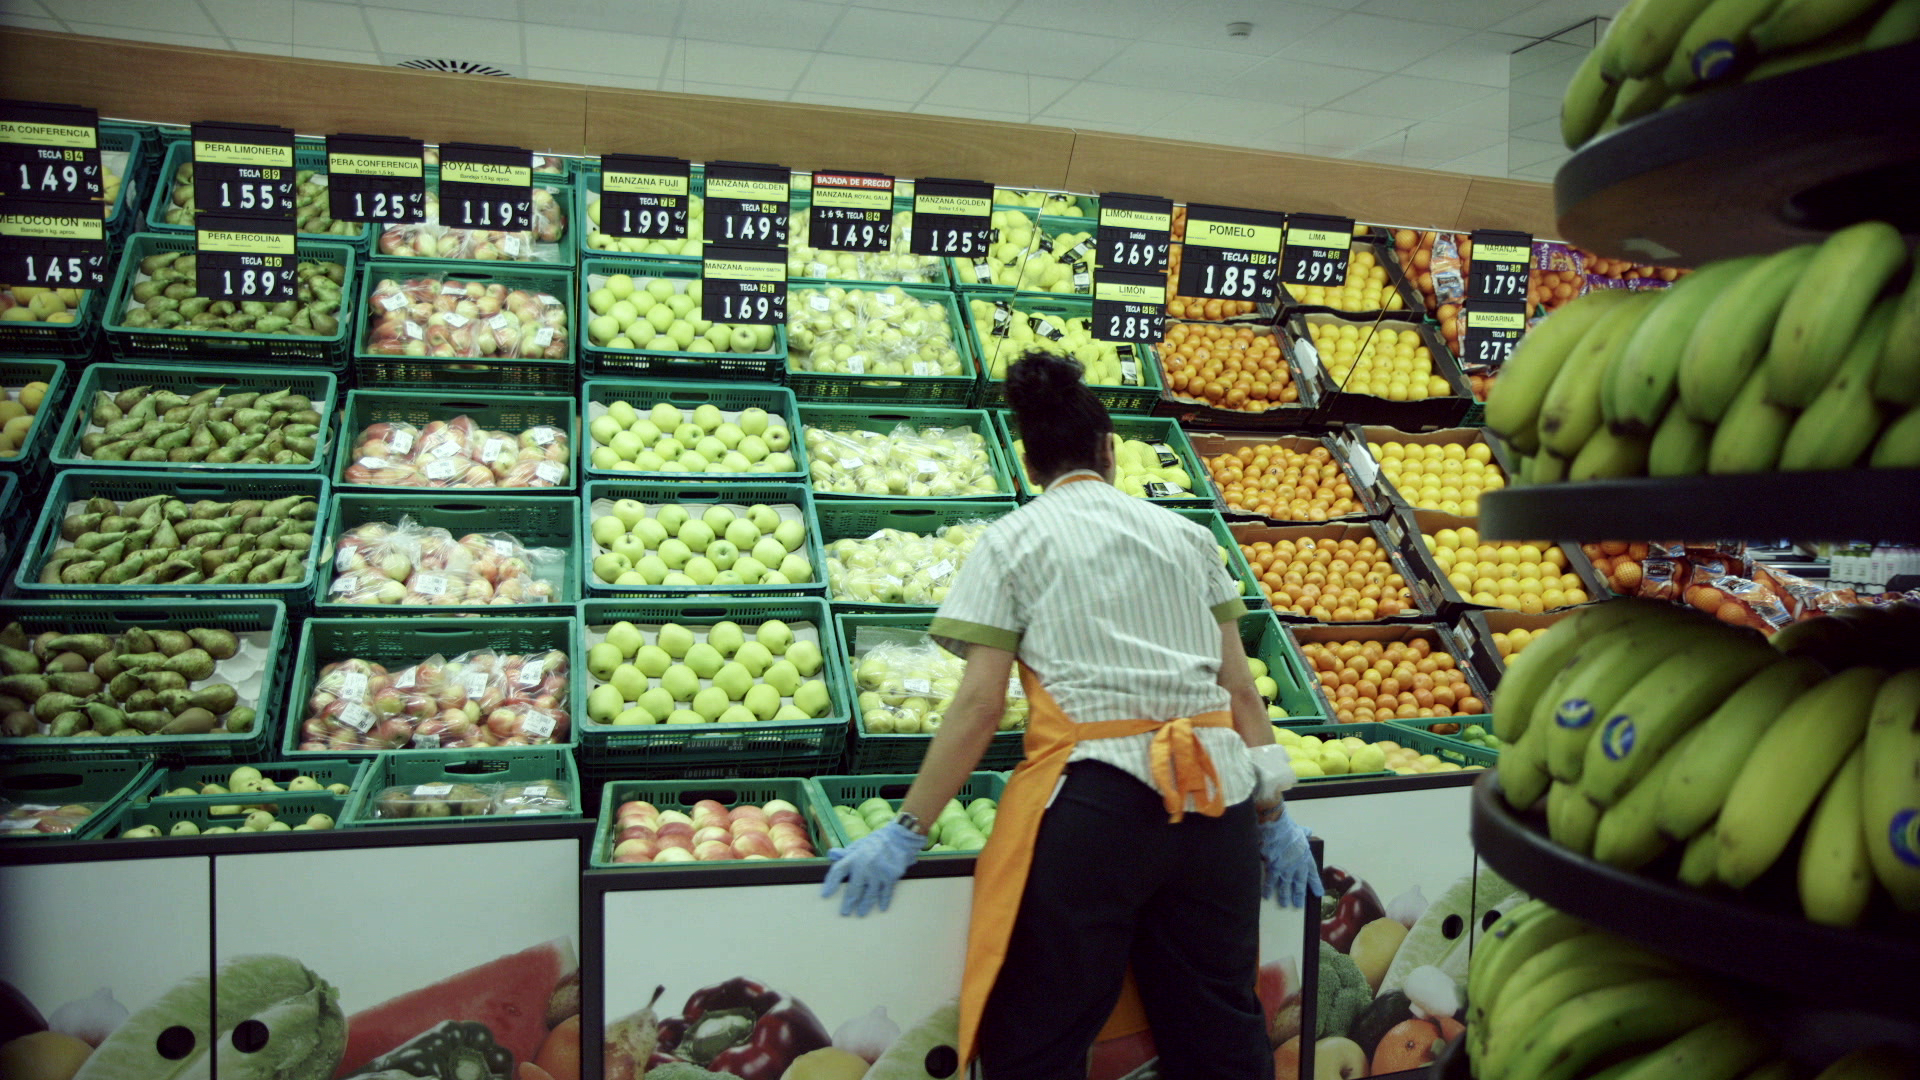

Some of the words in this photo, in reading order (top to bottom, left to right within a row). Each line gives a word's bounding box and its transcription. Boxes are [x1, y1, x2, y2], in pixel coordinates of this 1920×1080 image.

[0, 124, 15, 133] RA
[17, 125, 90, 138] CONFERENCIA
[205, 143, 232, 153] PERA
[234, 145, 285, 156] LIMONERA
[38, 149, 62, 160] TECLA
[331, 158, 355, 166] PERA
[356, 160, 419, 169] CONFERENCIA
[442, 162, 478, 172] ROYAL
[482, 164, 512, 175] GALA
[238, 169, 261, 178] TECLA
[610, 175, 657, 186] MANZANA
[659, 178, 679, 188] FUJI
[708, 179, 750, 189] MANZANA
[752, 183, 785, 191] GOLDEN
[817, 176, 847, 185] BAJADA
[850, 178, 860, 186] DE
[862, 179, 891, 187] PRECIO
[816, 190, 852, 199] MANZANA
[639, 197, 658, 206] TECLA
[919, 196, 954, 205] MANZANA
[956, 197, 986, 206] GOLDEN
[741, 203, 760, 212] TECLA
[846, 211, 864, 220] TECLA
[1134, 213, 1153, 221] MALLA
[1209, 224, 1256, 238] POMELO
[208, 232, 233, 241] PERA
[235, 233, 281, 243] ERCOLINA
[1308, 233, 1326, 241] LIMA
[1484, 244, 1518, 253] NARANJA
[241, 256, 262, 265] TECLA
[1222, 252, 1249, 262] TECLA
[705, 263, 743, 271] MANZANA
[739, 283, 758, 292] TECLA
[1476, 314, 1514, 322] MANDARINA
